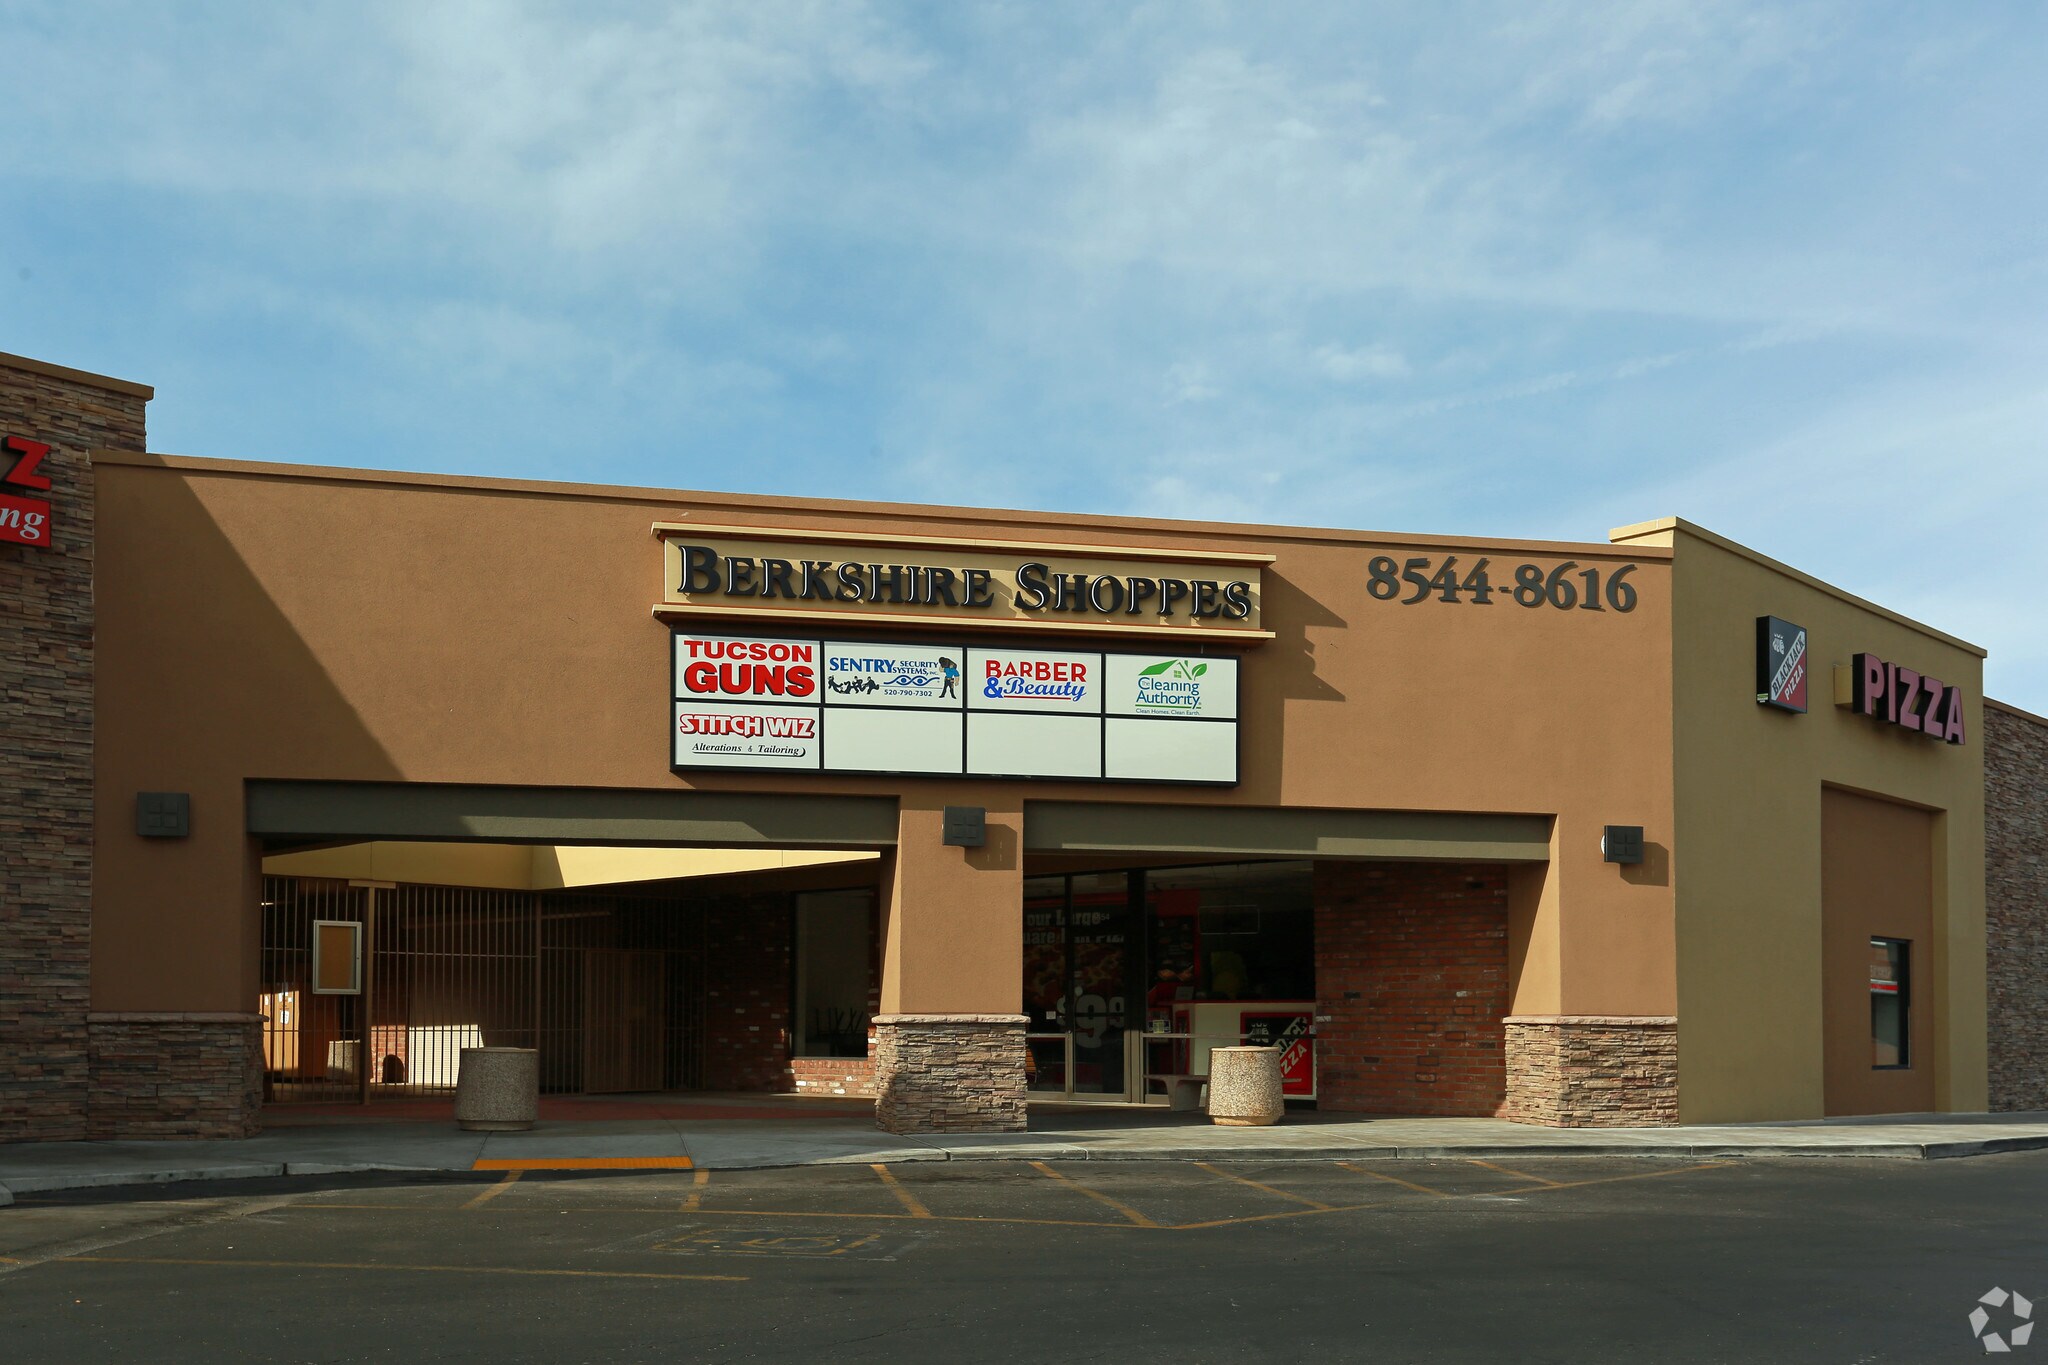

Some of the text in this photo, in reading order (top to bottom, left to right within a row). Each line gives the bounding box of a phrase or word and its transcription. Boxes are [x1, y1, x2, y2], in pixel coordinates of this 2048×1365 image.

[677, 545, 1251, 619] BERKSHIRE SHOPPES
[1367, 556, 1638, 612] 8544-8616
[684, 640, 812, 662] TUCSON
[829, 657, 896, 674] SENTRY
[892, 666, 929, 676] SYSTEMS,
[900, 660, 939, 669] SECURITY
[986, 660, 1087, 682] BARBER
[684, 661, 815, 697] GUNS
[983, 676, 1087, 702] & Beauty
[1138, 676, 1200, 696] Cleaning
[1784, 665, 1804, 701] PIZZA
[884, 689, 933, 697] 520-790-7302
[1136, 690, 1200, 709] Authority
[1860, 653, 1965, 745] PIZZA
[680, 714, 815, 738] STITCH WIZ
[692, 743, 742, 752] Alterations
[758, 744, 800, 756] Tailoring
